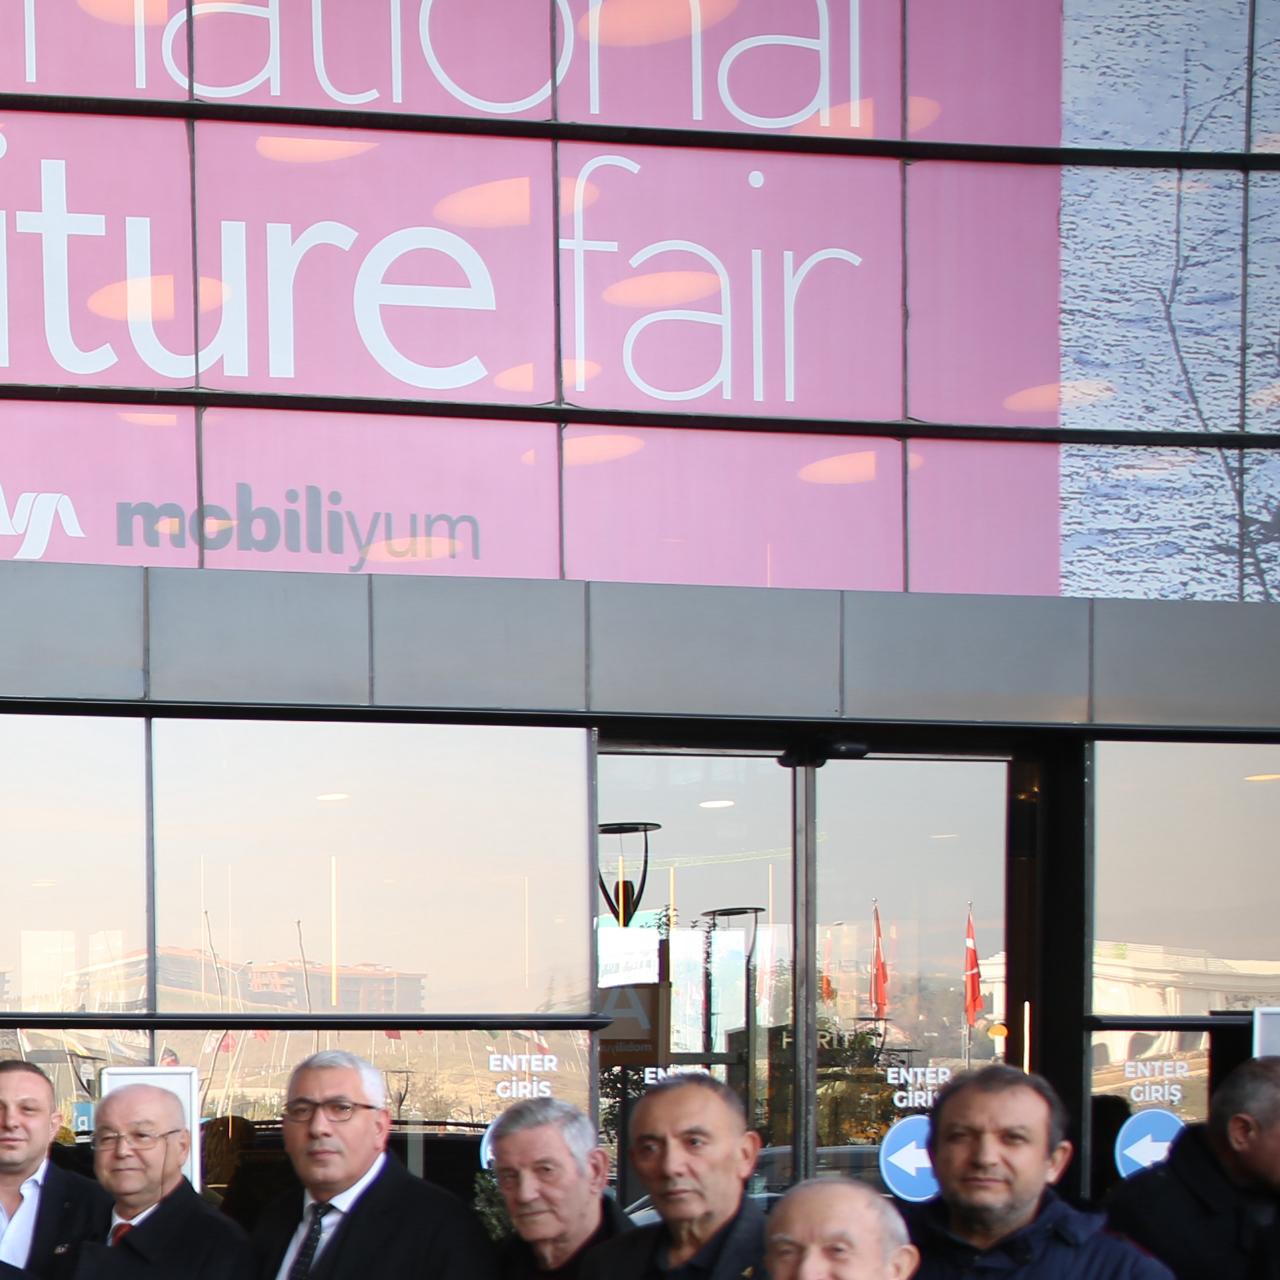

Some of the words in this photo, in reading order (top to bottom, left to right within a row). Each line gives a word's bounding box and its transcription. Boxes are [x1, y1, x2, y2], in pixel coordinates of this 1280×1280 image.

[559, 155, 862, 401] fair
[116, 482, 481, 572] mobiliyum
[489, 1055, 557, 1071] ENTER
[1125, 1061, 1189, 1078] ENTER
[887, 1067, 951, 1084] ENTER
[893, 1086, 938, 1108] GİRİ
